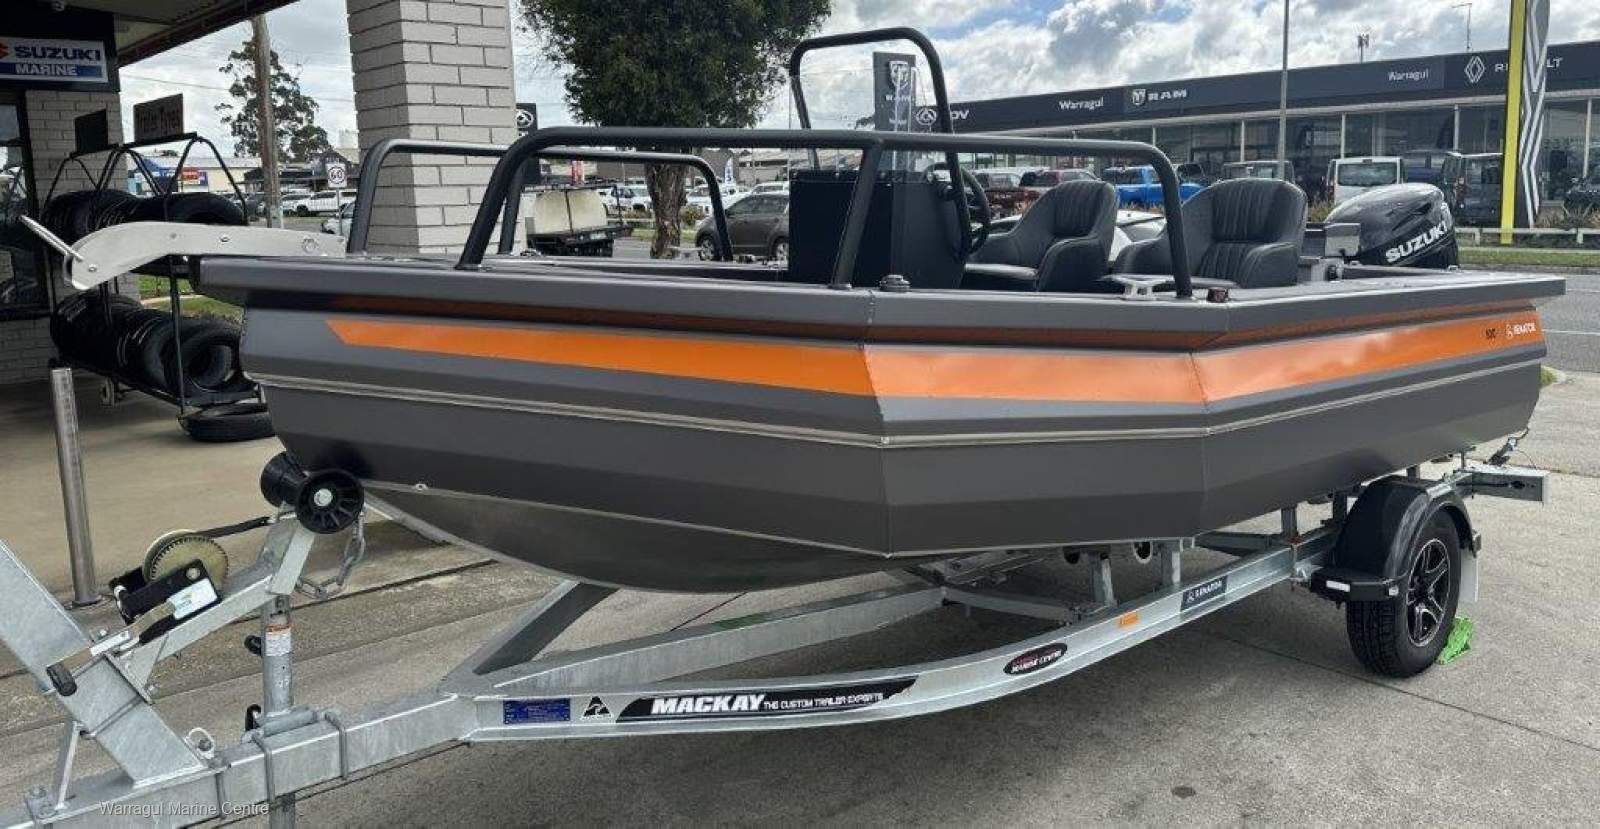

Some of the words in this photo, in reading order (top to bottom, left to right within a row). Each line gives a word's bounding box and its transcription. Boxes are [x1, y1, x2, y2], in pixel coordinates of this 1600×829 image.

[15, 46, 100, 61] SUZUKI
[15, 63, 77, 77] MARINE
[1387, 69, 1429, 81] Warragul
[1147, 89, 1187, 101] RAM
[1059, 97, 1104, 111] Warragul
[331, 170, 343, 180] 60
[1385, 221, 1447, 263] SUZUKI
[651, 694, 765, 714] MACKAY
